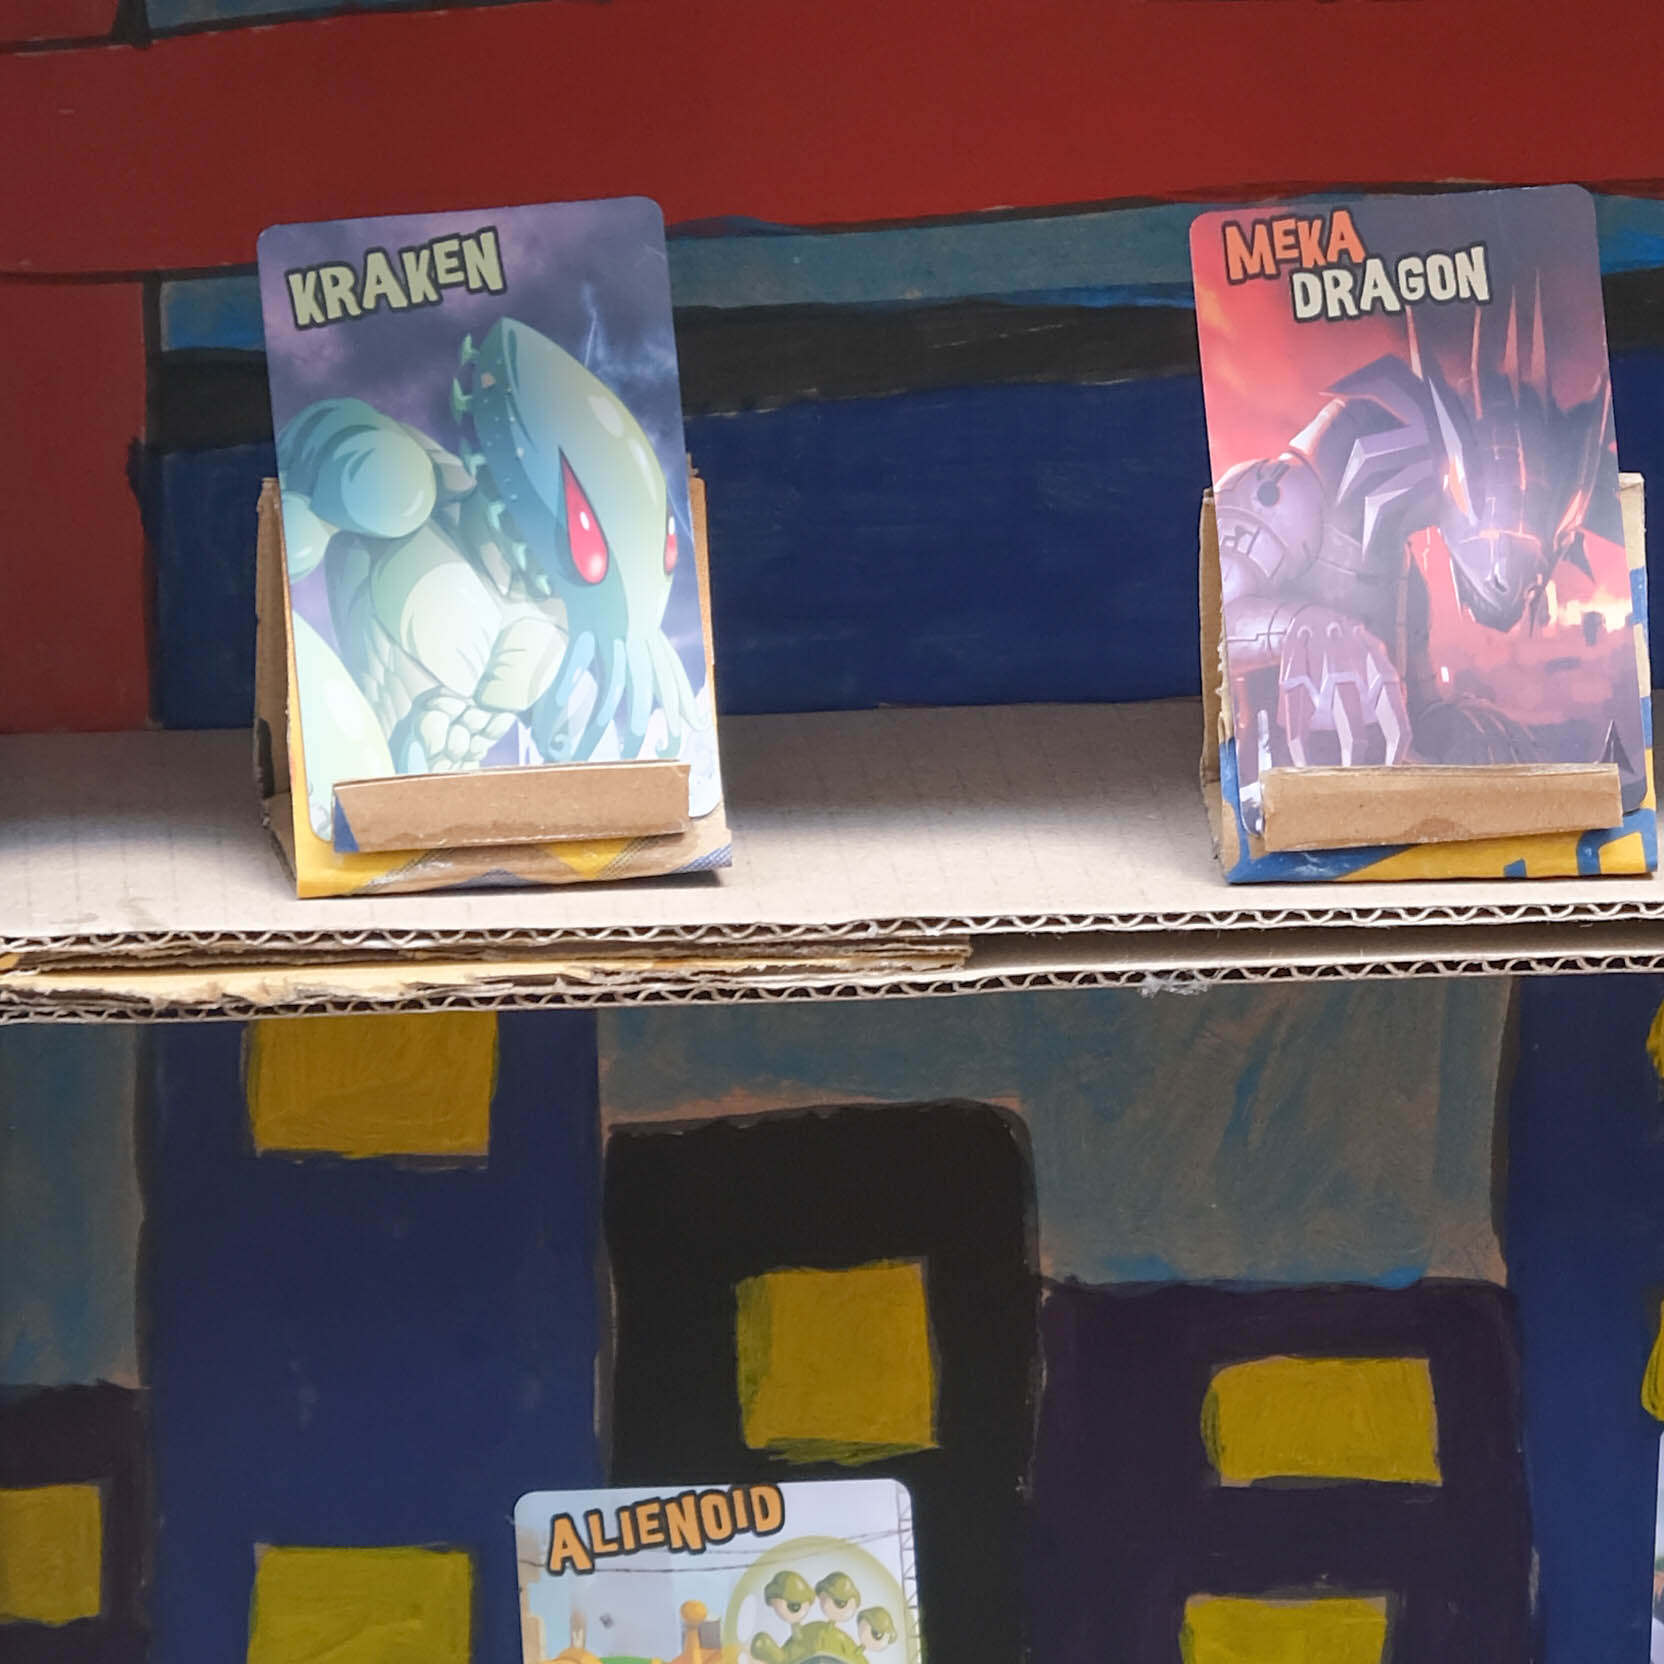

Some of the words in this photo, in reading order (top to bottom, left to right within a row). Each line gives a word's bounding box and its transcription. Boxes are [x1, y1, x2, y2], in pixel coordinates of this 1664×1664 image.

[285, 225, 507, 330] KRAKEN
[1222, 208, 1367, 285] MEKA
[1289, 242, 1492, 321] DRAGON
[545, 1483, 786, 1576] ALIENOID
